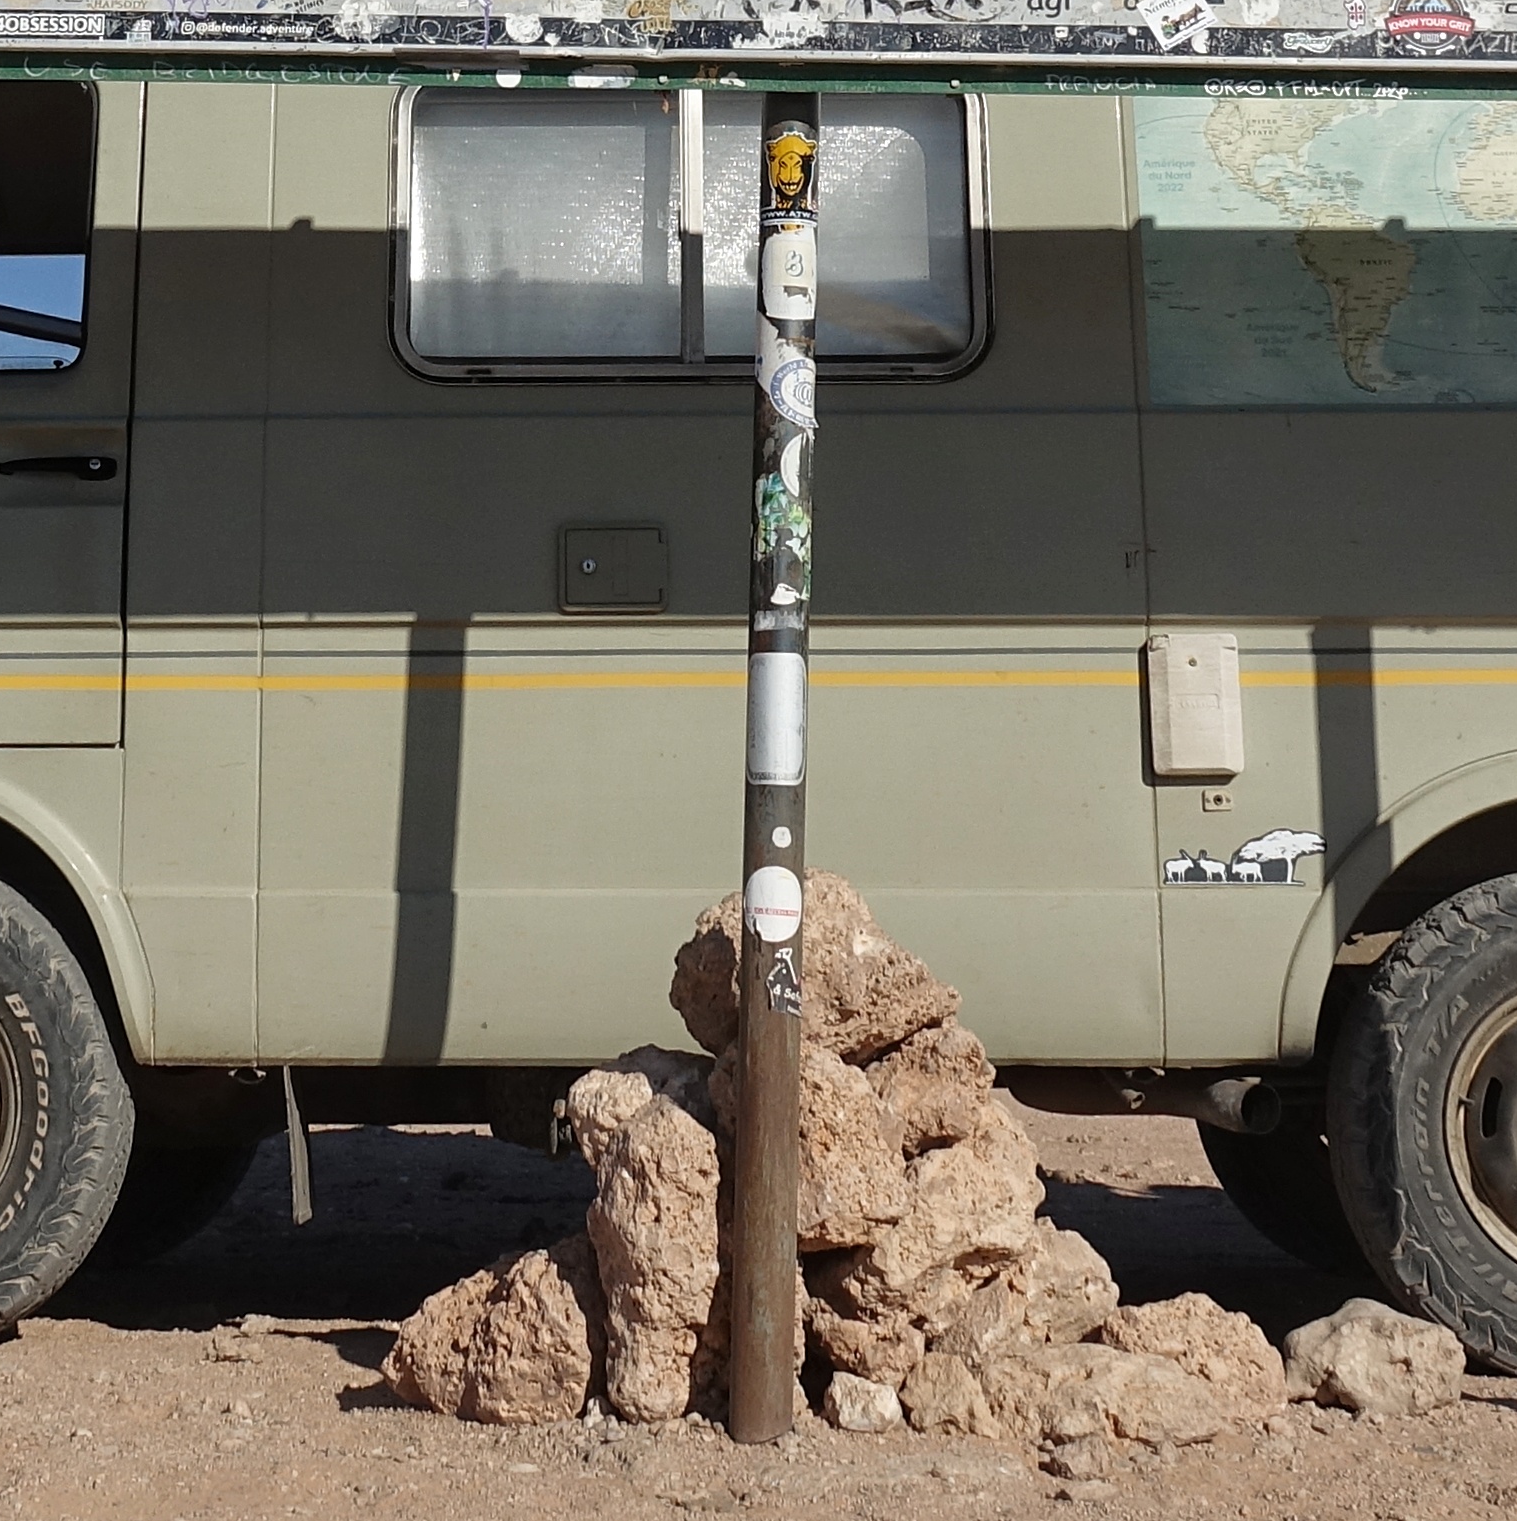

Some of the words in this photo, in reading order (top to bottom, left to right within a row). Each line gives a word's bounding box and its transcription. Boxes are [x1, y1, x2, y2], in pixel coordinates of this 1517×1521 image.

[1388, 18, 1418, 32] KNOW
[1419, 16, 1448, 27] YOUR
[1449, 18, 1473, 32] GRIT
[1161, 171, 1192, 180] Nord
